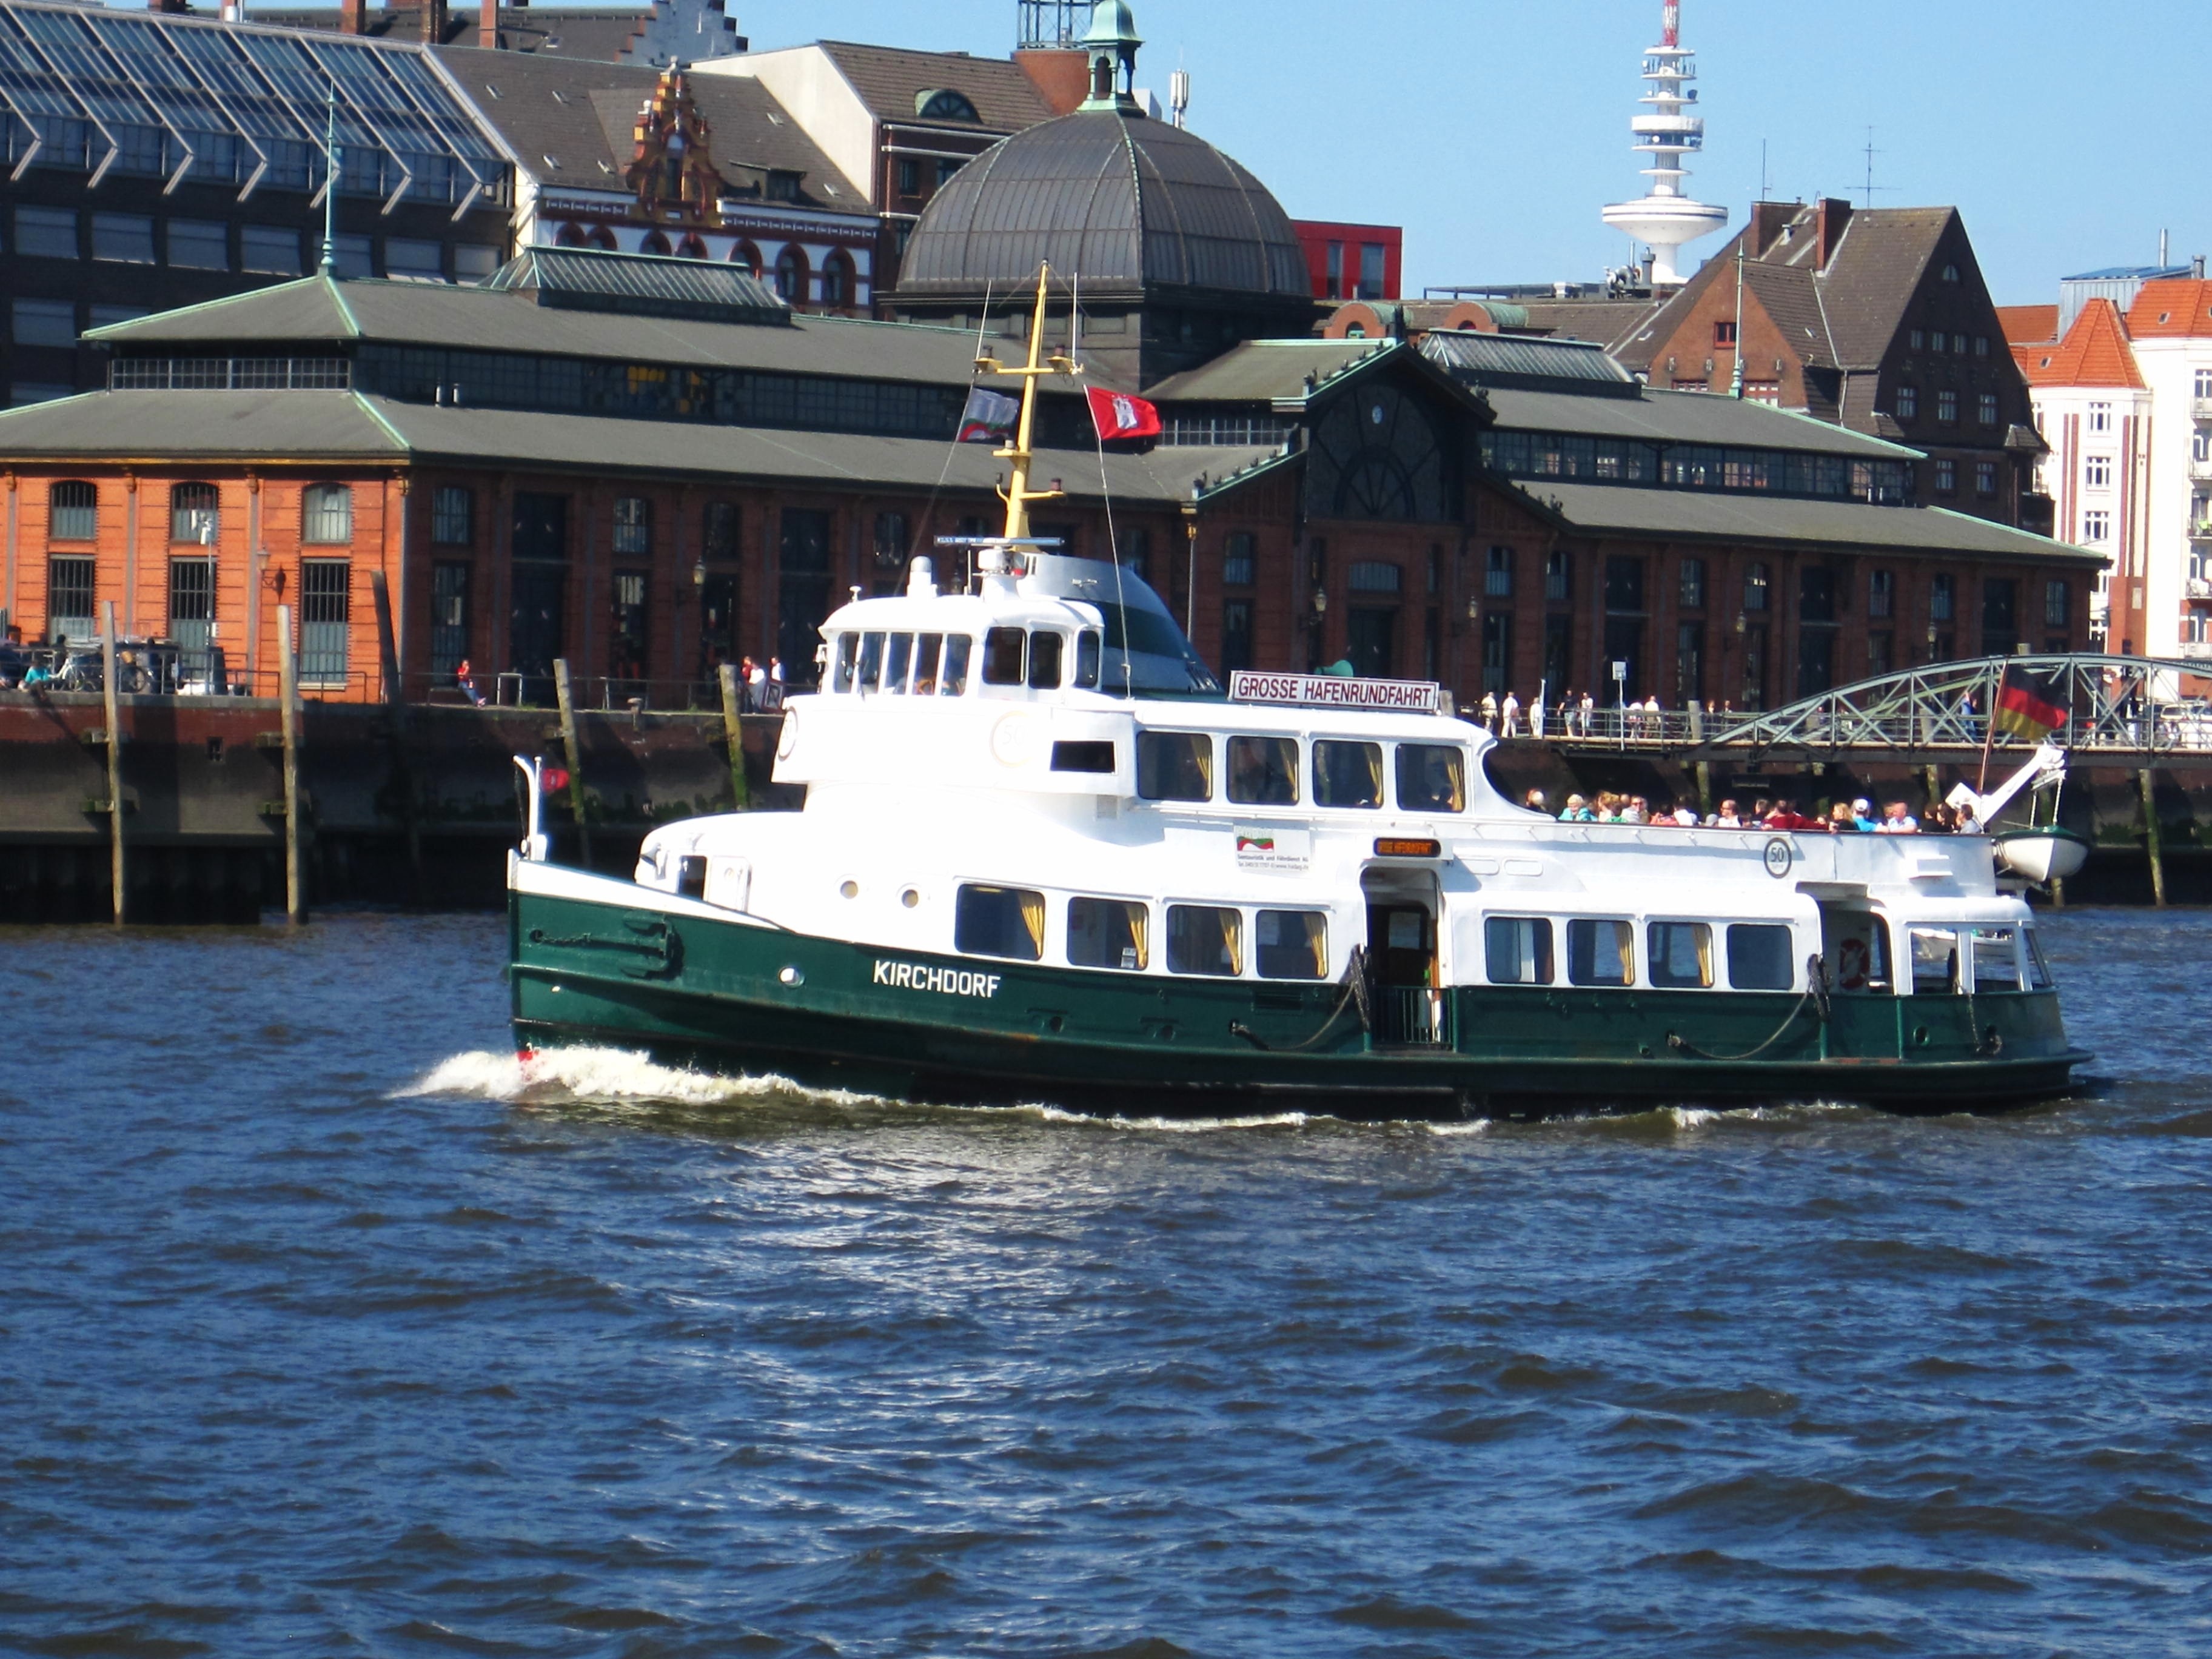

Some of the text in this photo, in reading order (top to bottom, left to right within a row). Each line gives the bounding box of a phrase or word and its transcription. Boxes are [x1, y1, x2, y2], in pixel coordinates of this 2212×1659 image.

[1238, 676, 1431, 708] GROSSE HAFENRUNDFAHRT
[1771, 846, 1785, 862] 50
[873, 960, 1000, 997] KIRCHDORF
